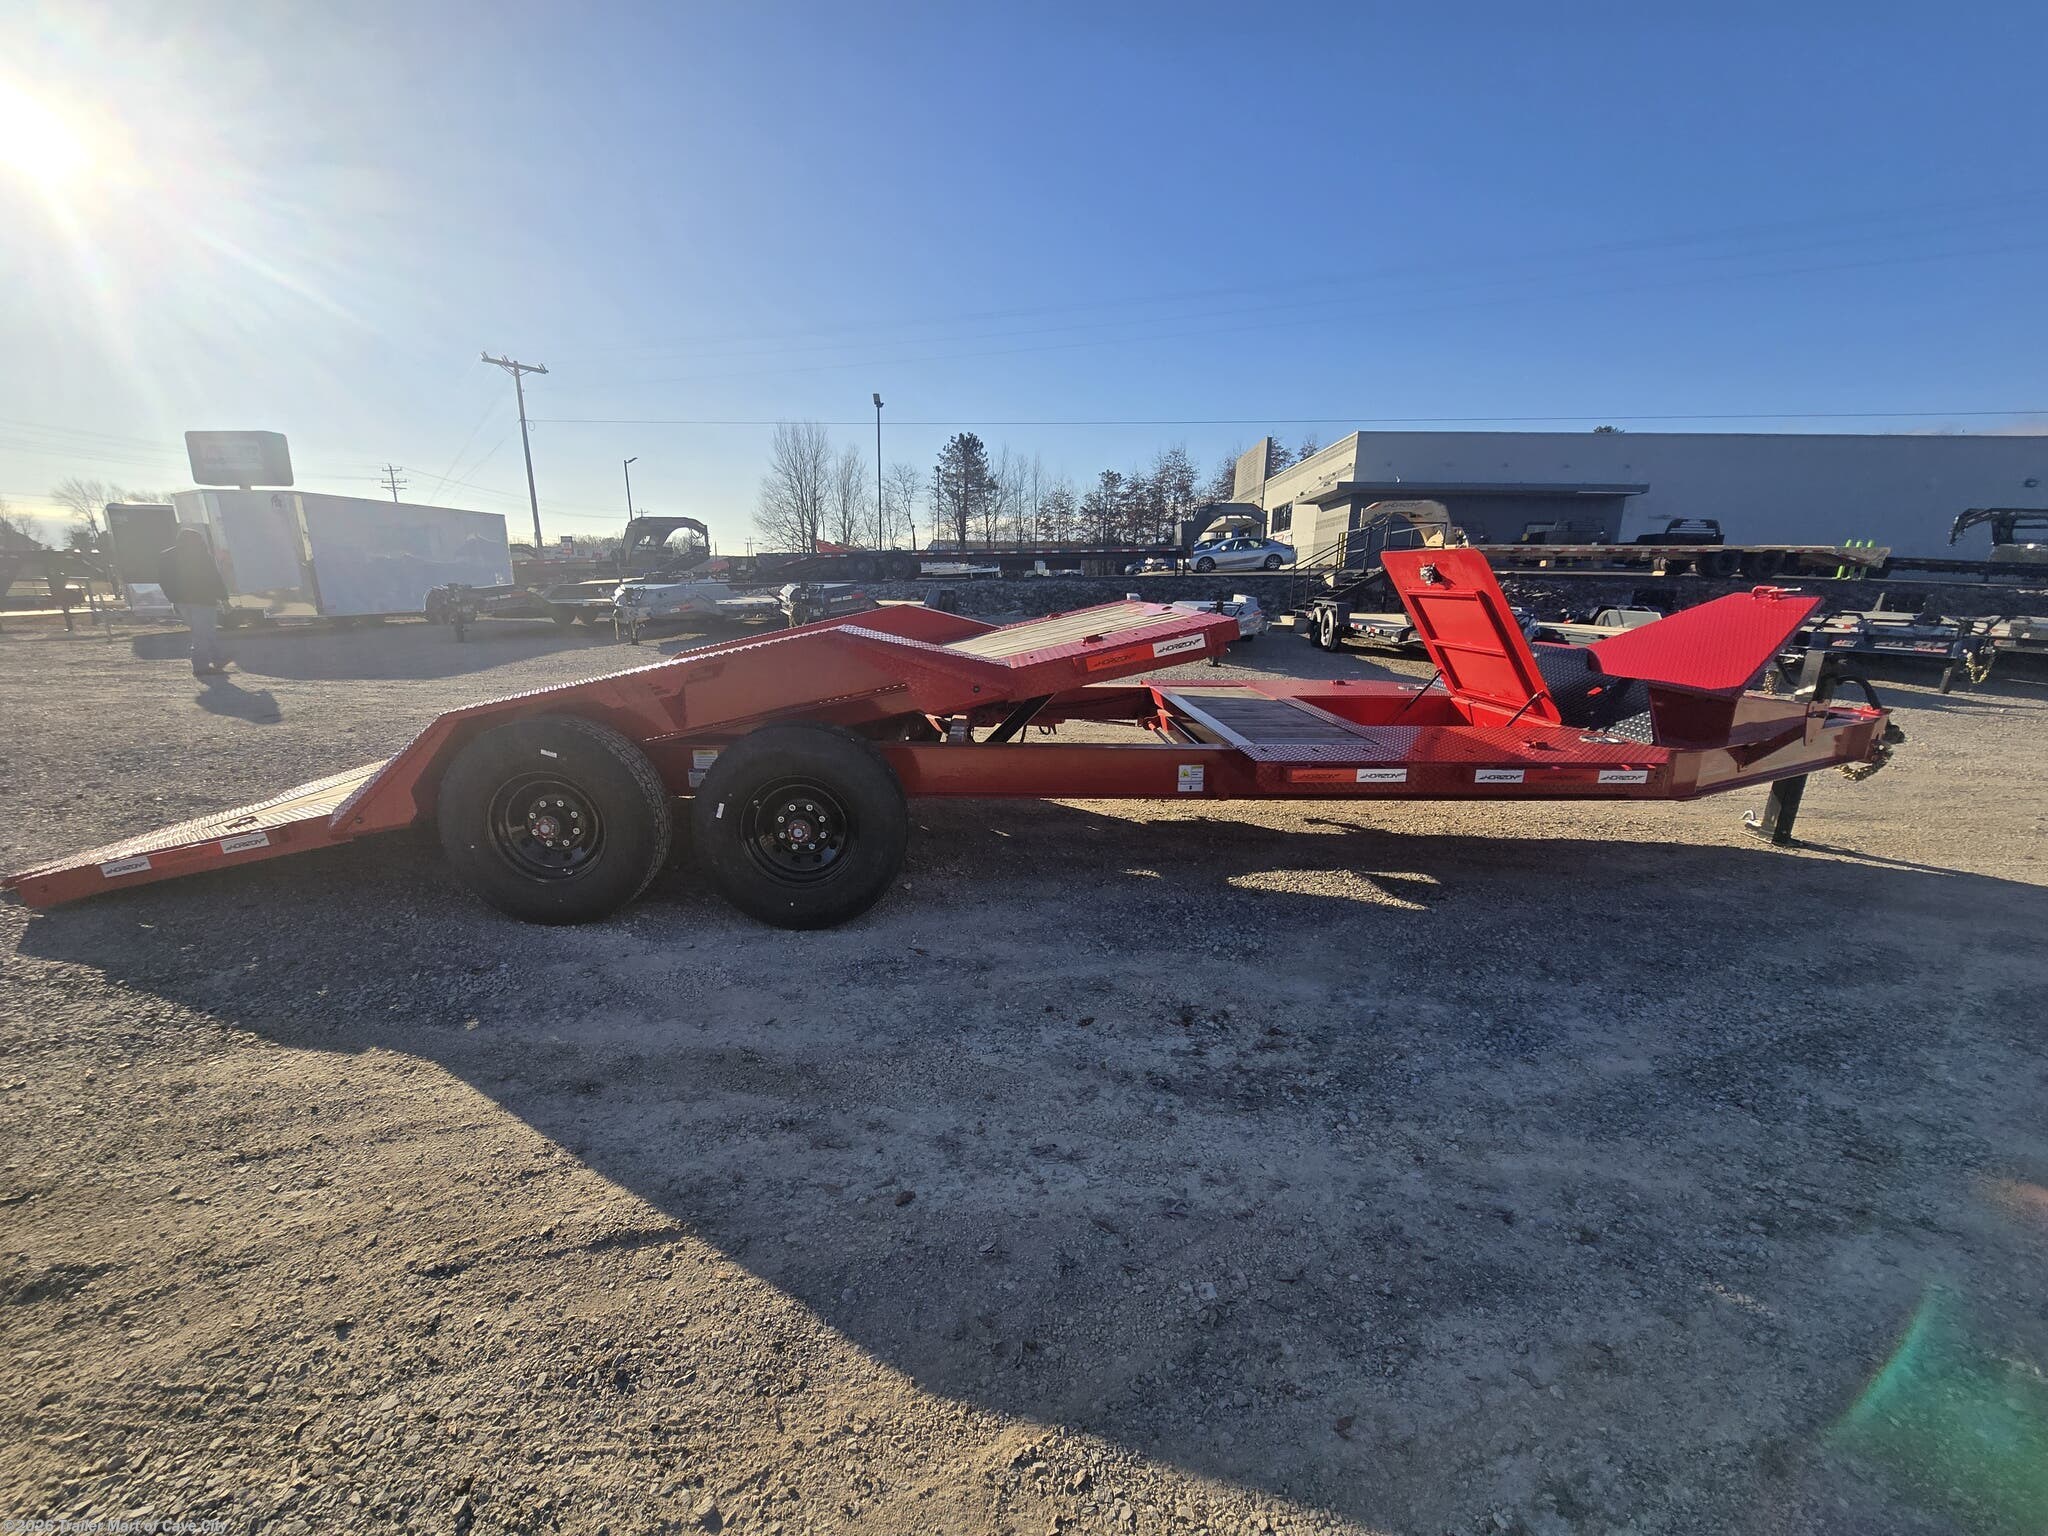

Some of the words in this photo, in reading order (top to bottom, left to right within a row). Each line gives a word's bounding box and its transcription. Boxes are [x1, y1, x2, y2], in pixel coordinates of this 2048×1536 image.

[1156, 638, 1202, 654] HORIZON
[1359, 772, 1406, 780] HORIZON
[225, 837, 266, 852] HORIZON
[105, 861, 147, 875] HORIZON
